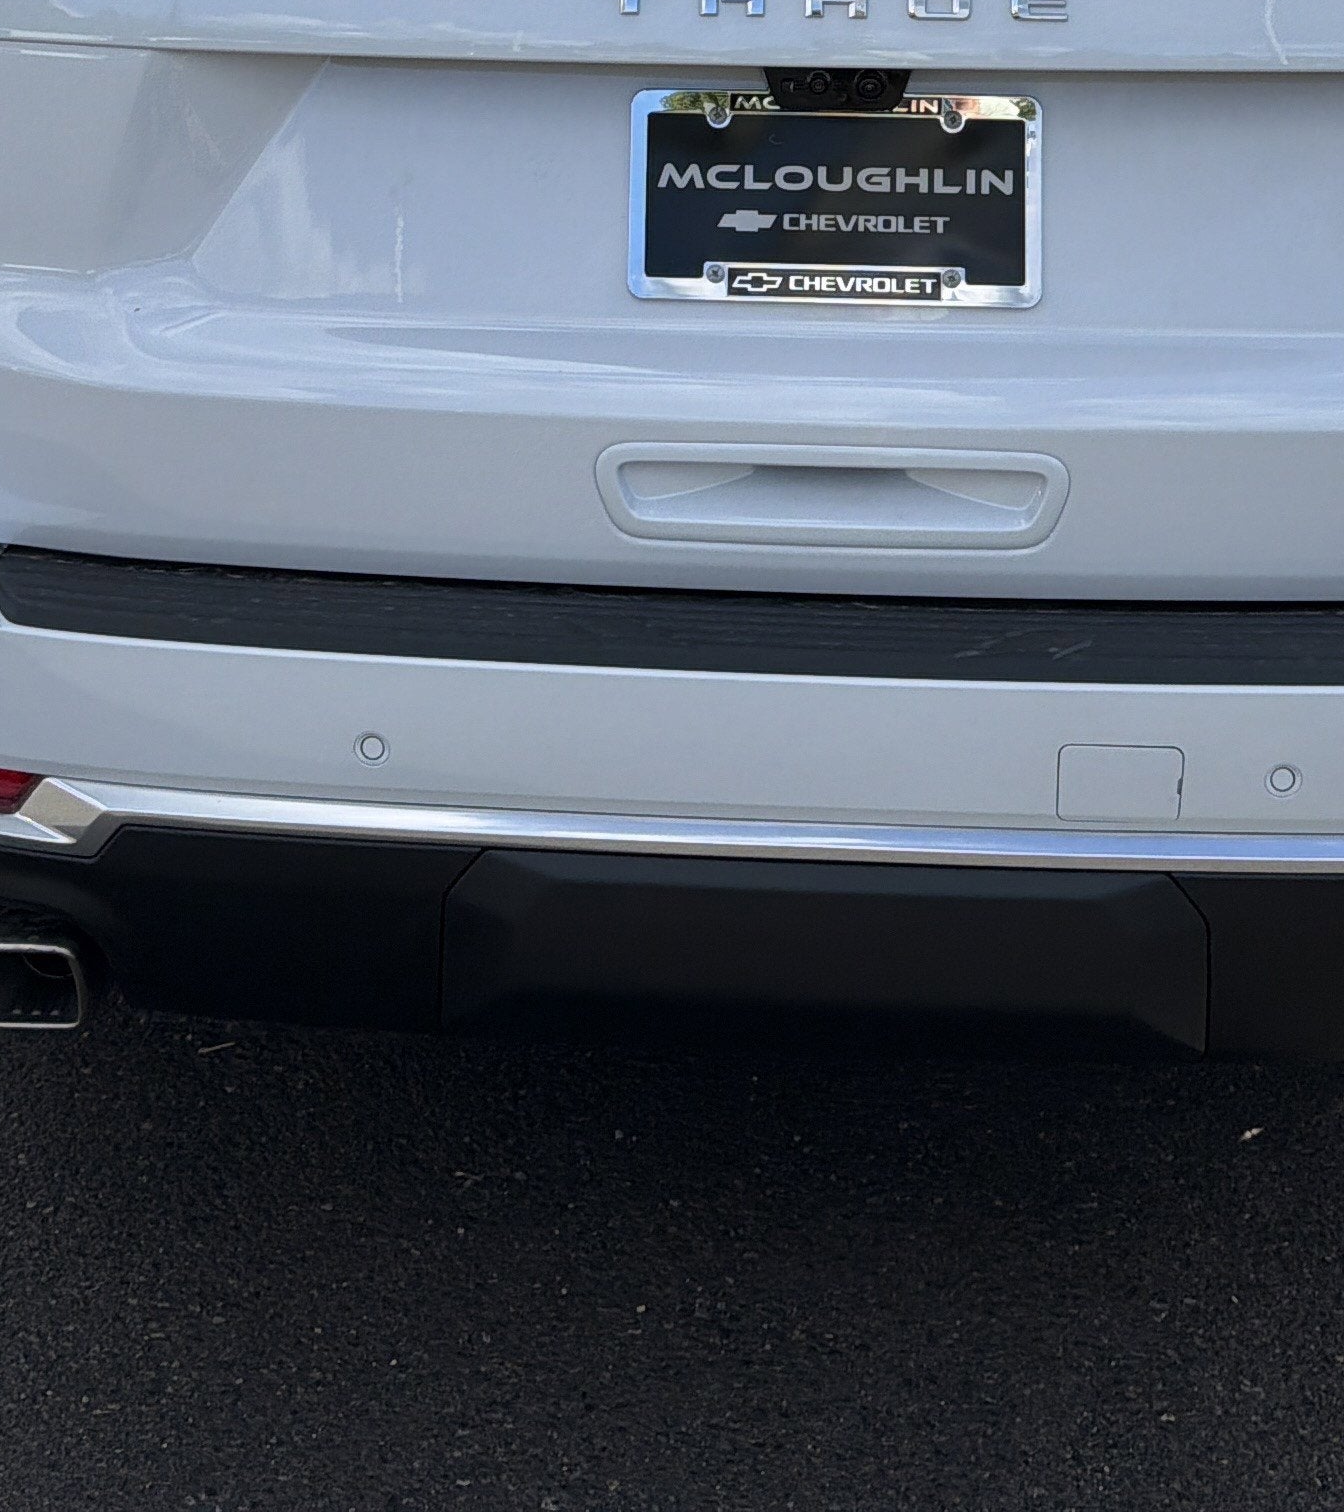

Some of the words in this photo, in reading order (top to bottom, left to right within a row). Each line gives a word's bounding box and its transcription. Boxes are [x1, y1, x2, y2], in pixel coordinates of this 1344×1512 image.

[657, 162, 1015, 196] MCLOUGHLIN
[782, 212, 951, 235] CHEVROLET
[788, 274, 938, 295] CHEVROLET
